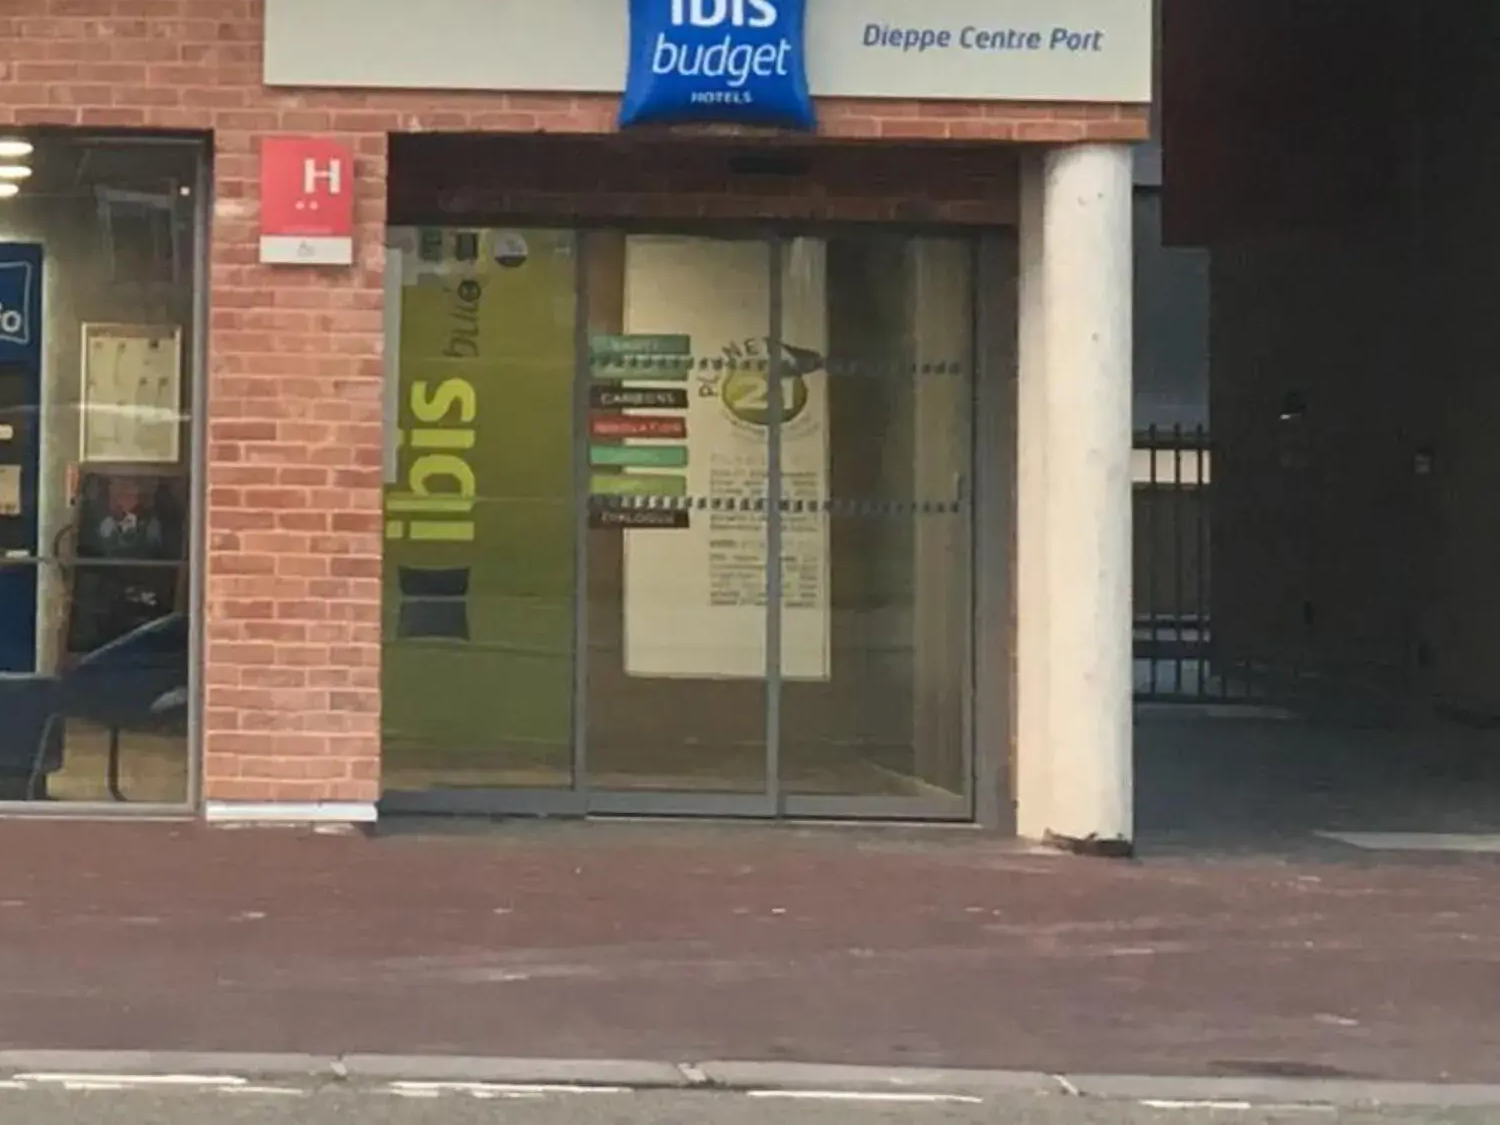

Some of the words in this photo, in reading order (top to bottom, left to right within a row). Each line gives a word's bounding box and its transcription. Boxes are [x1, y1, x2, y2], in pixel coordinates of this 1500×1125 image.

[862, 23, 952, 53] Dieppe
[959, 26, 1042, 50] Centre
[1049, 27, 1105, 52] Port
[652, 32, 792, 87] budget
[690, 91, 753, 104] HOTELS
[304, 158, 341, 193] H
[385, 377, 477, 541] ibis
